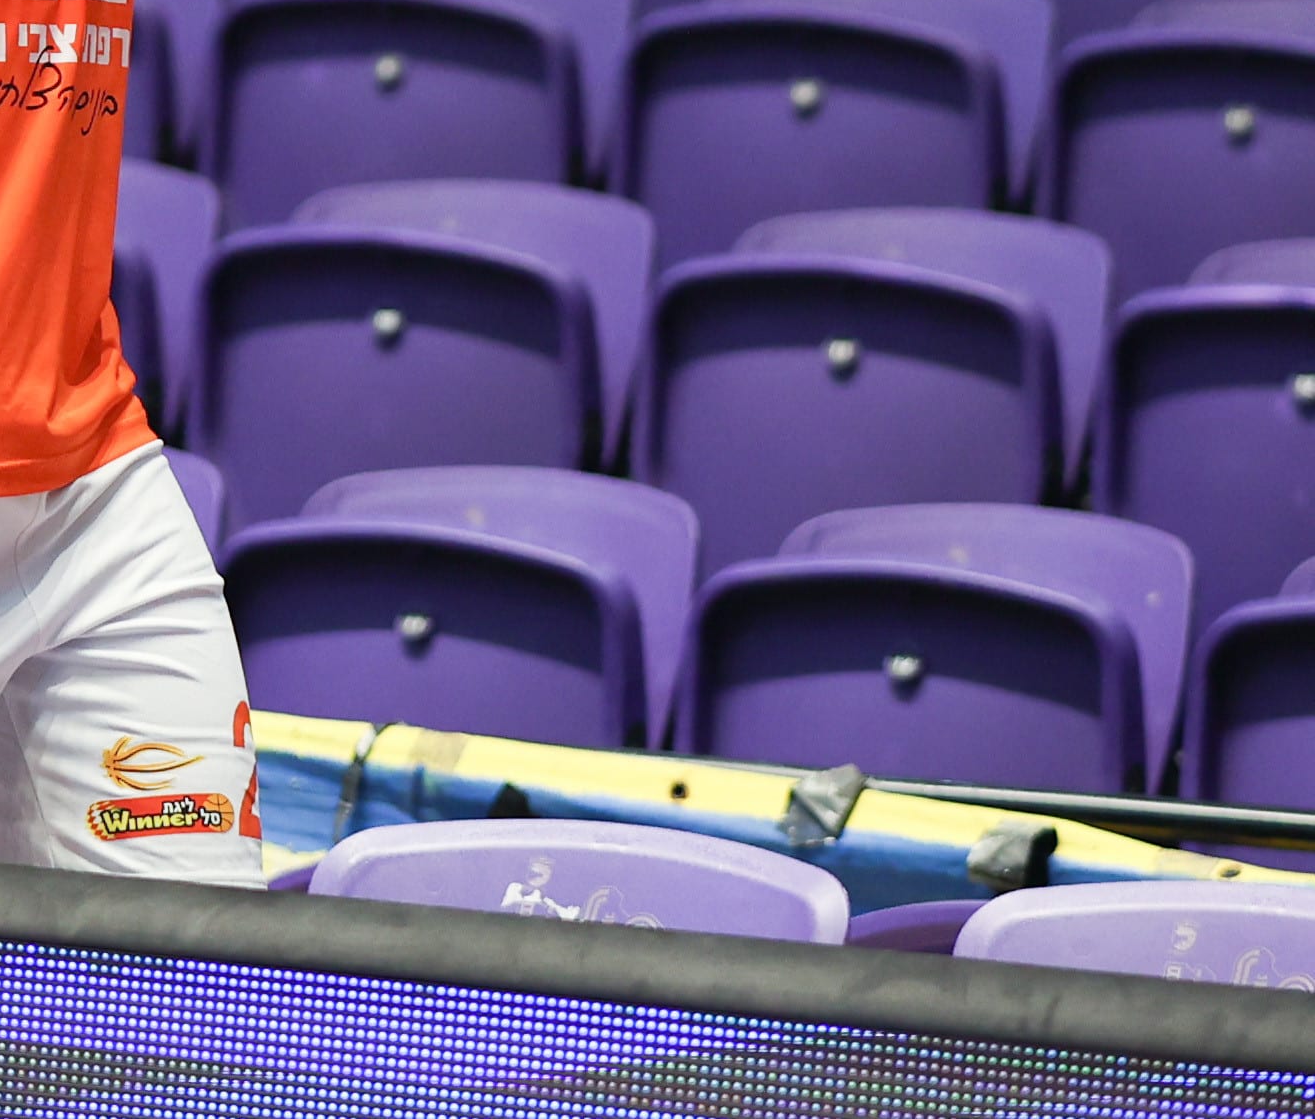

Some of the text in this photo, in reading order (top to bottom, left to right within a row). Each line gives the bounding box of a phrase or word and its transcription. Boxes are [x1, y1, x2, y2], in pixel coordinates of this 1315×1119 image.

[162, 797, 195, 814] ליגת
[101, 808, 199, 834] Winner
[200, 808, 221, 826] סל
